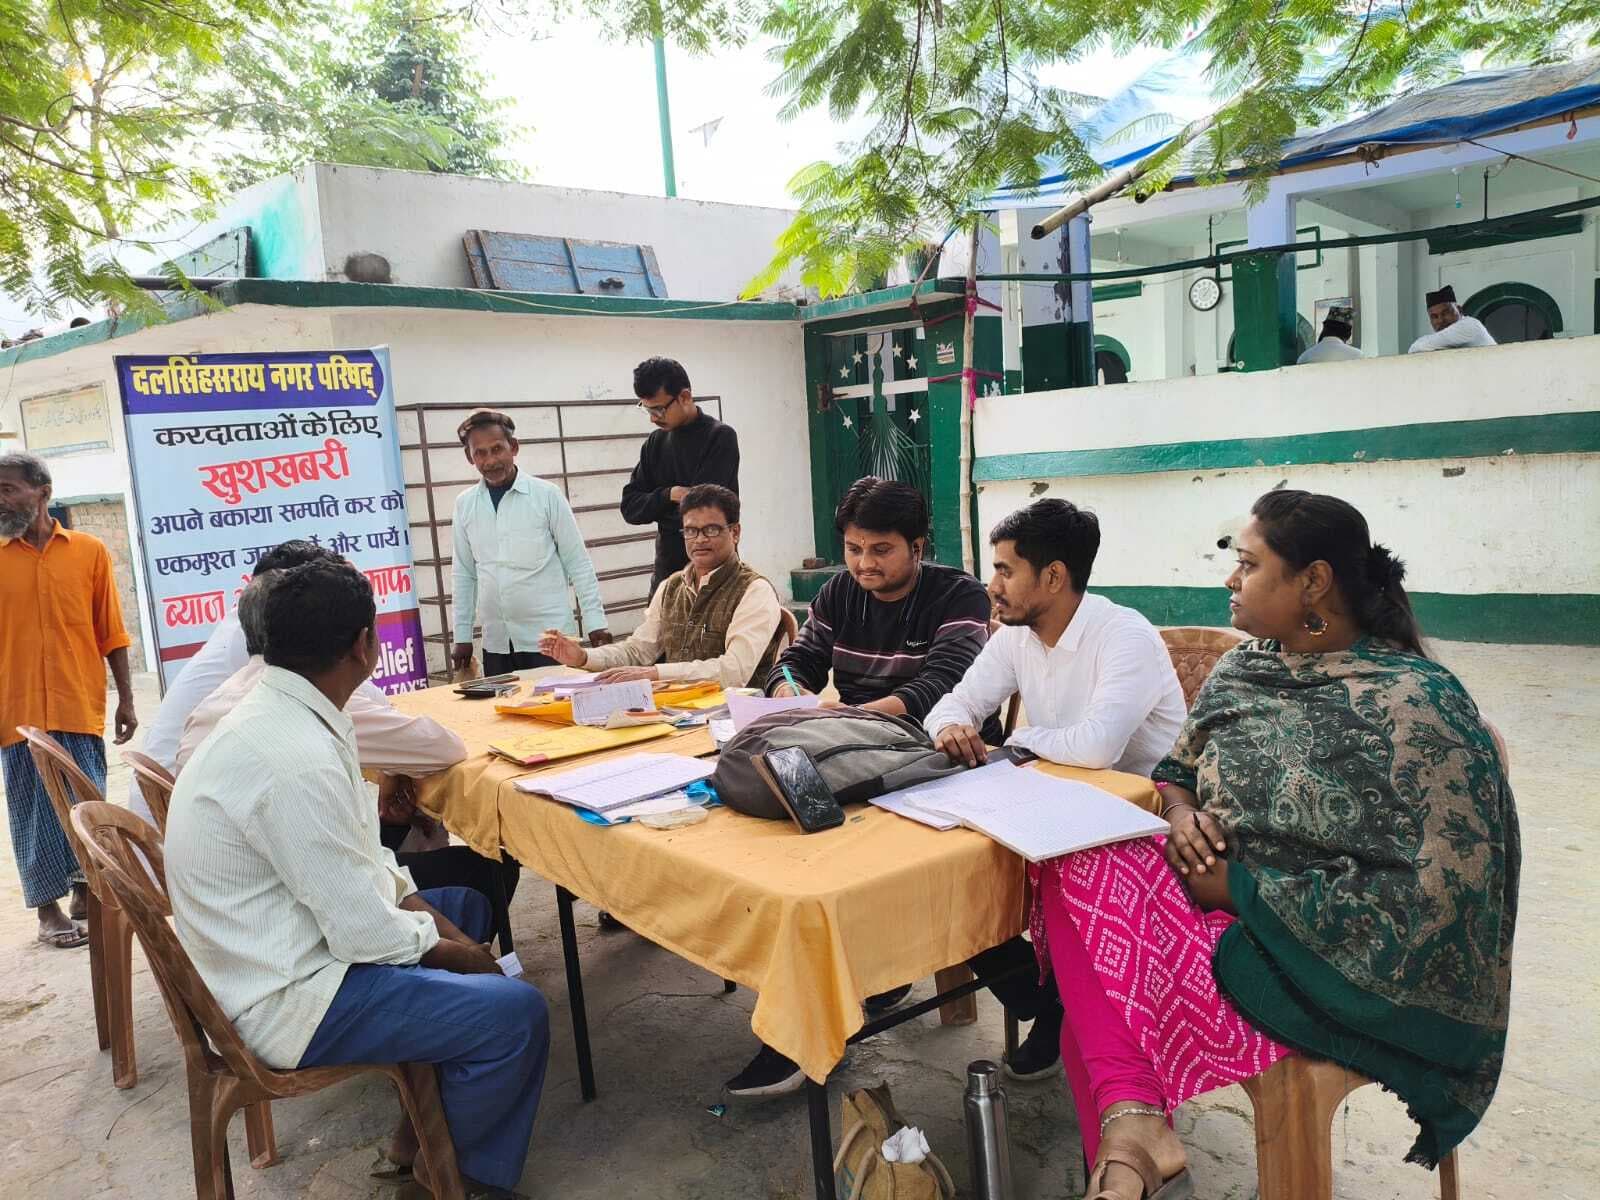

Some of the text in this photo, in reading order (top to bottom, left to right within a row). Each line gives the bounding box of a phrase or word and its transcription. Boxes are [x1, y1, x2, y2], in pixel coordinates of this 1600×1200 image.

[130, 354, 378, 399] दलसिंहसराय नगर परिषद्
[153, 409, 383, 447] करदाताओं के लिए
[198, 438, 350, 505] खुशखबरी
[151, 508, 204, 535] अपने
[209, 506, 273, 528] बकाया
[344, 496, 376, 514] कर
[380, 489, 405, 511] को
[155, 549, 237, 577] एकमुश्त
[328, 531, 362, 554] और
[162, 590, 226, 628] ब्याज
[371, 637, 415, 680] elief
